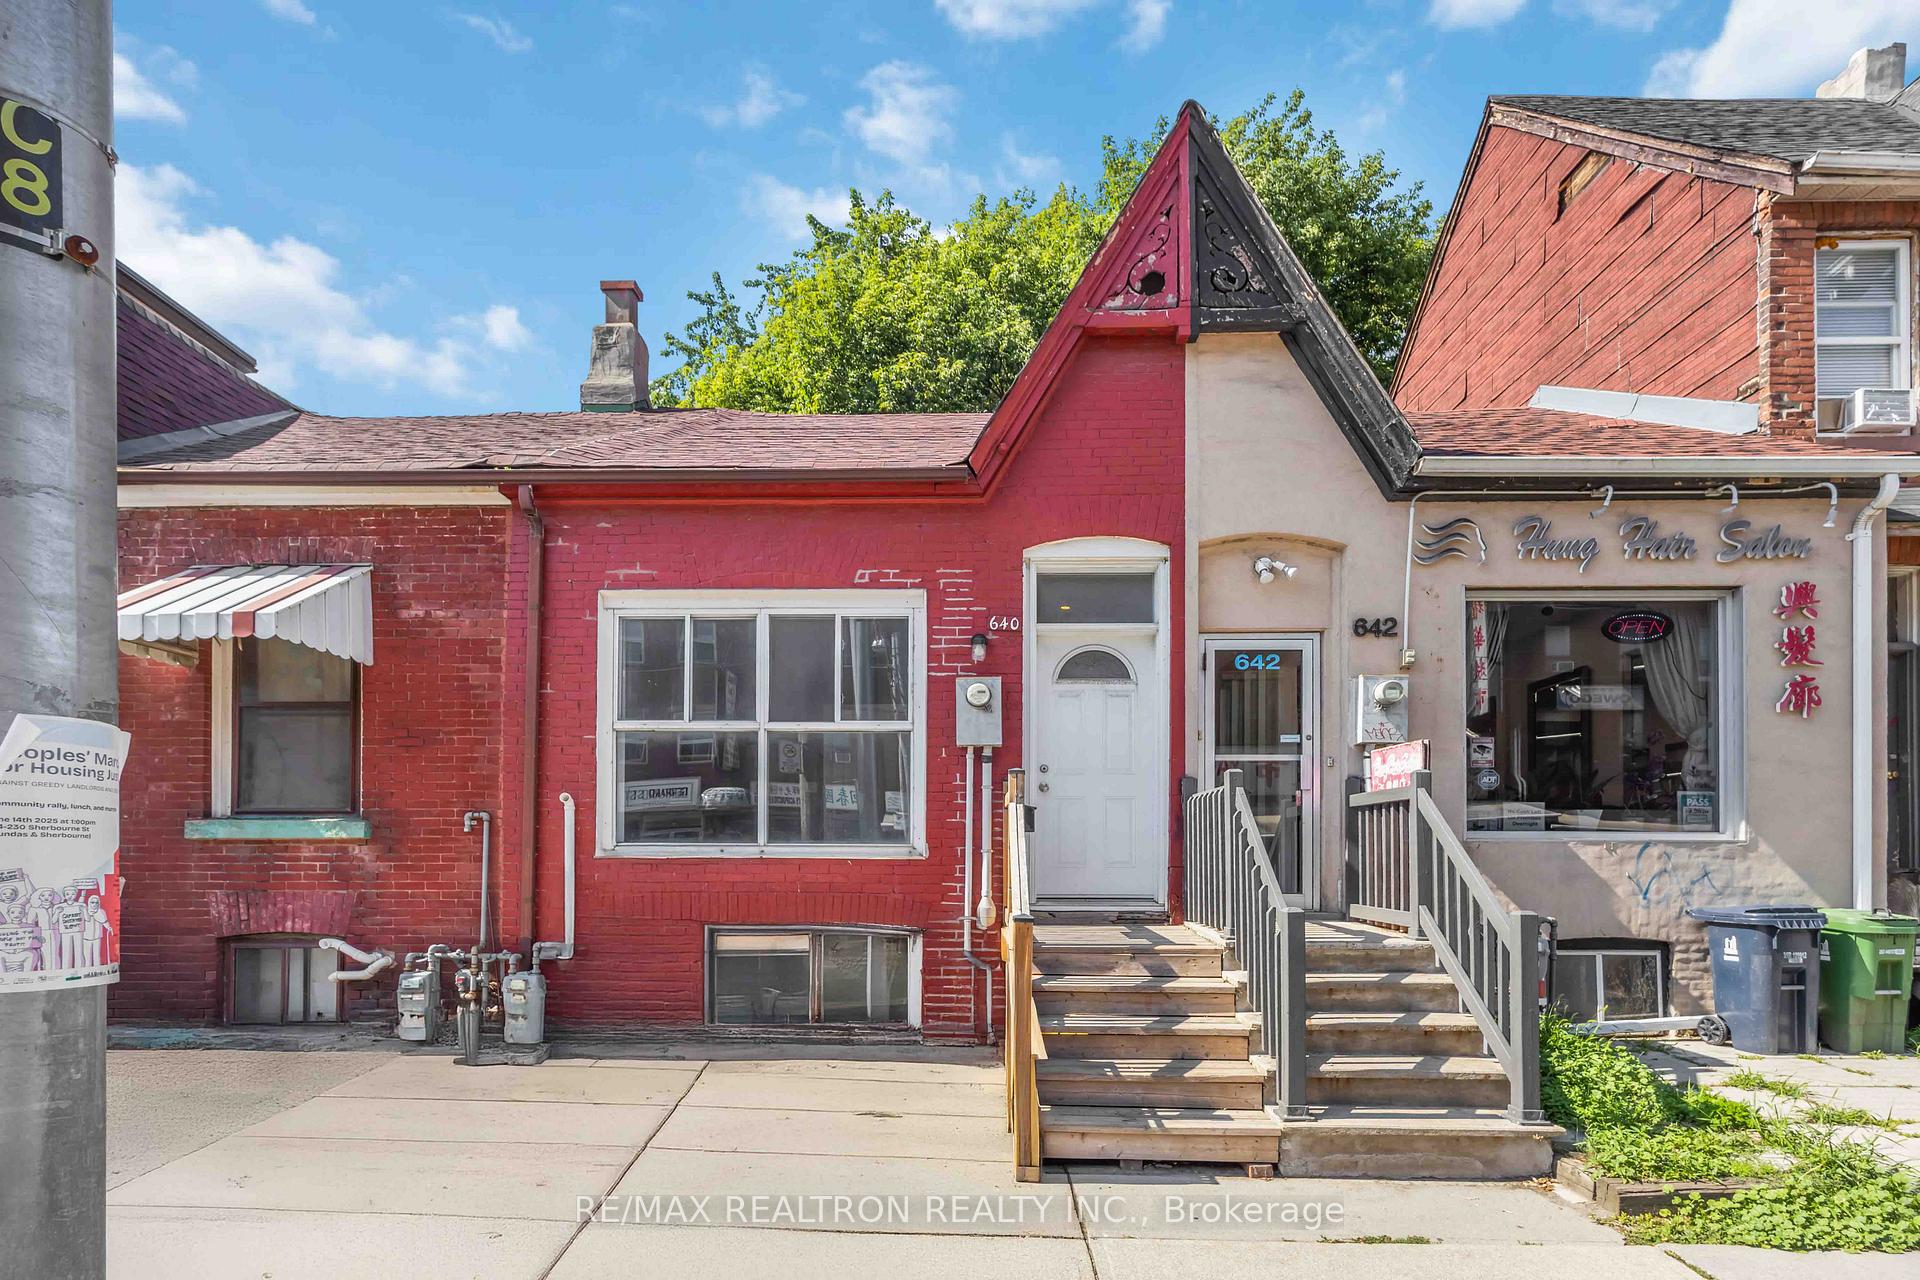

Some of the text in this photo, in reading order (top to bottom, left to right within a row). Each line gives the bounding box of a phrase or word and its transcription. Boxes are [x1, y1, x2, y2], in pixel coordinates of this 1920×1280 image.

[1, 158, 51, 216] 8
[1513, 515, 1813, 574] Hung Hair Salon
[989, 615, 1020, 631] 640
[1353, 617, 1398, 638] 642
[1608, 620, 1667, 634] OPEN
[1234, 653, 1281, 671] 642
[18, 748, 90, 763] oples'
[31, 762, 104, 781] Housing
[31, 780, 65, 789] GREEDY
[1480, 776, 1497, 784] ADT
[1686, 798, 1709, 807] PASS
[28, 823, 80, 832] Sherbourne
